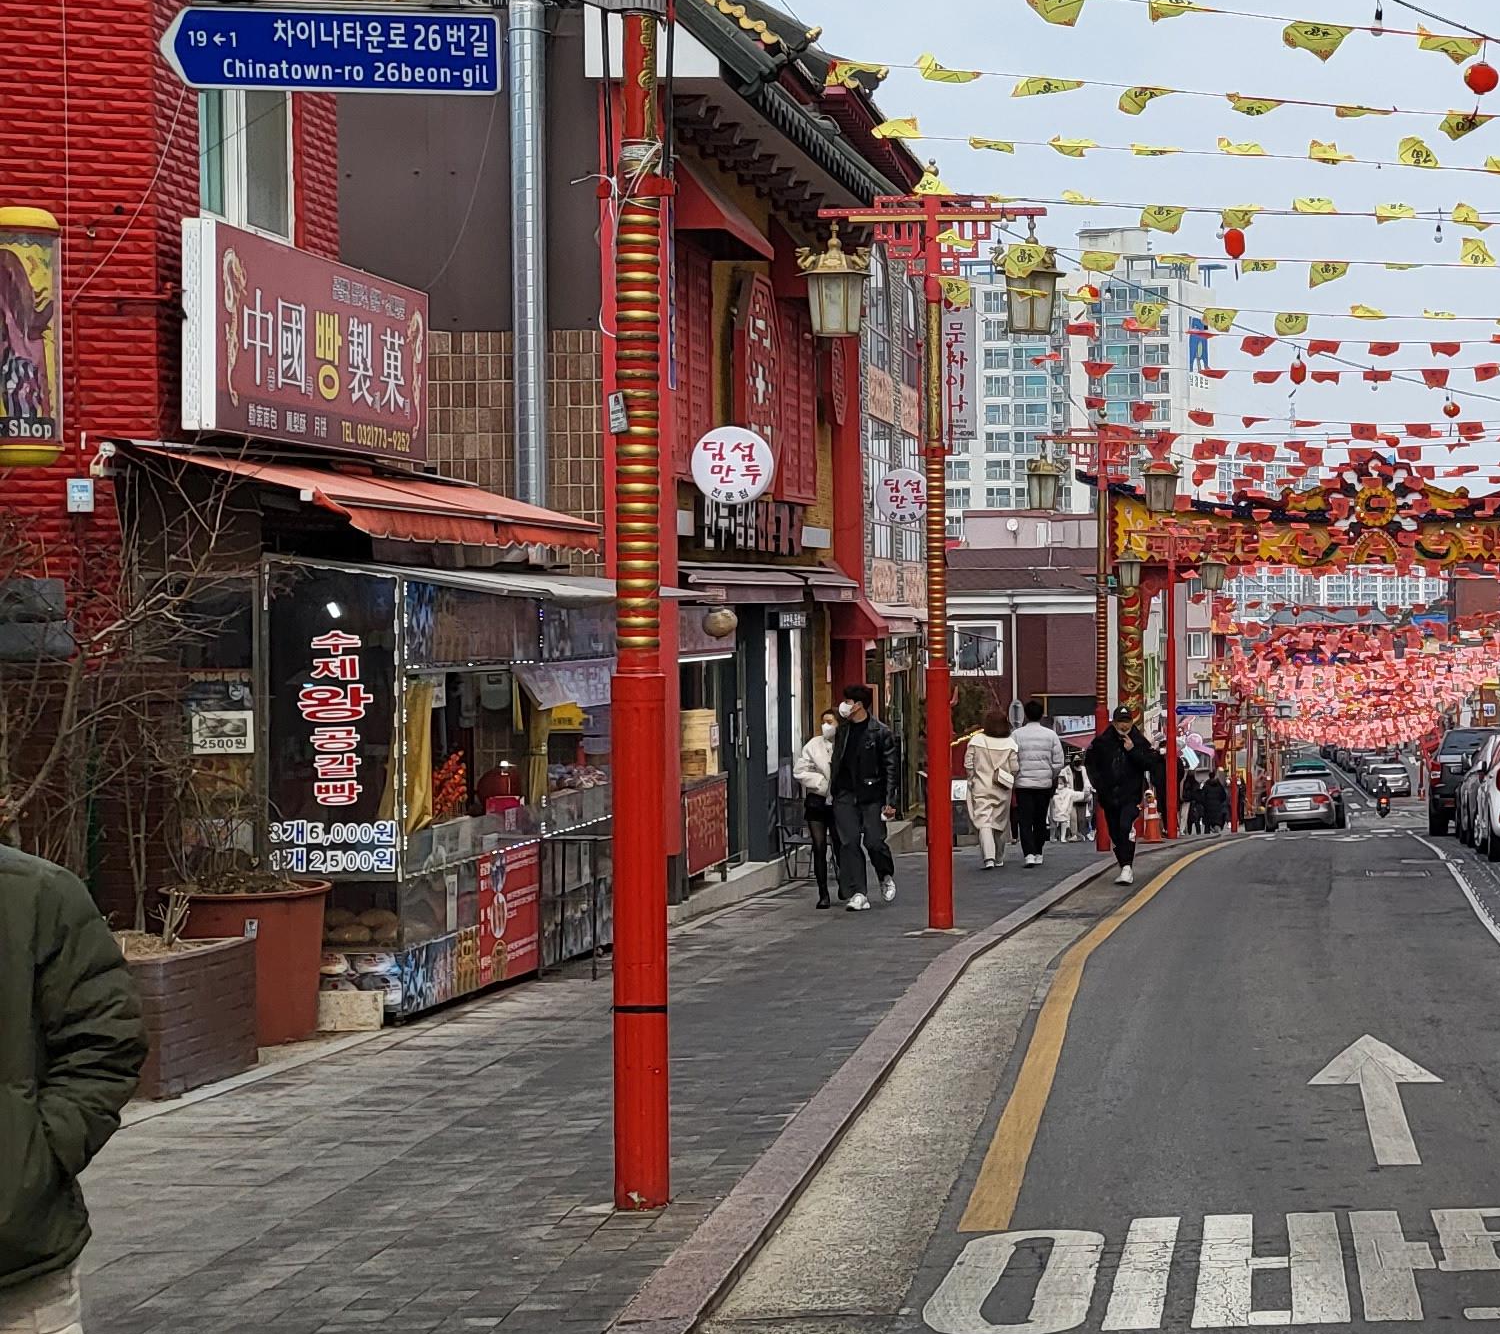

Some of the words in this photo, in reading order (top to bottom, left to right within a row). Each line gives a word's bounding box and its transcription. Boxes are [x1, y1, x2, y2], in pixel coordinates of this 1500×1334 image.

[188, 30, 207, 48] 19
[231, 31, 237, 48] 1
[223, 58, 364, 82] Chinatown-ro
[374, 63, 489, 87] 26beon-gil
[243, 288, 306, 394] 中國
[315, 310, 342, 400] 빵
[16, 418, 52, 441] Shop
[702, 441, 756, 462] 딤섬
[710, 464, 762, 486] 만두
[711, 487, 749, 502] 전문점
[884, 479, 921, 493] 딤섬
[890, 496, 927, 510] 만두
[200, 738, 246, 749] 2500원
